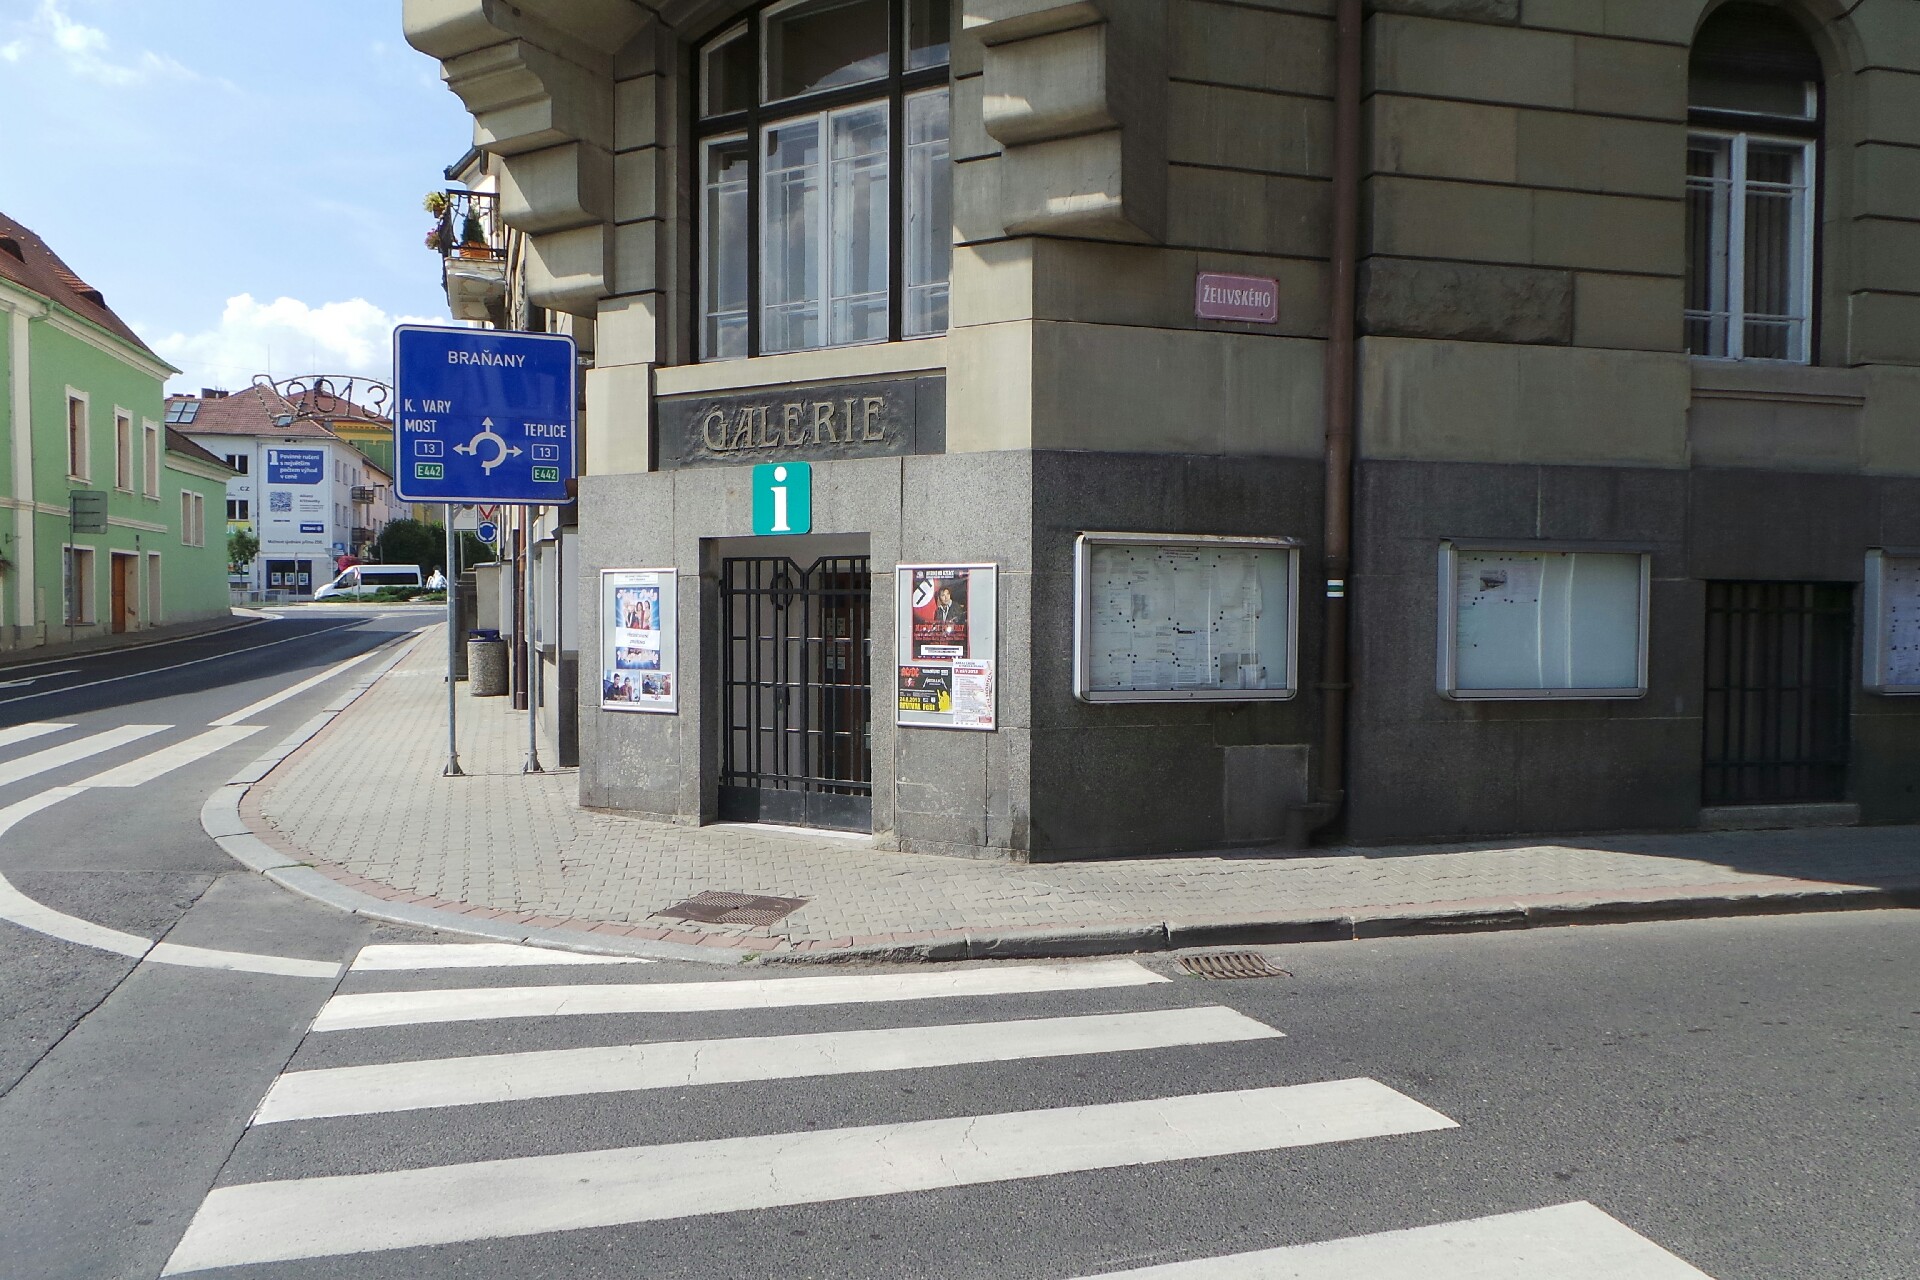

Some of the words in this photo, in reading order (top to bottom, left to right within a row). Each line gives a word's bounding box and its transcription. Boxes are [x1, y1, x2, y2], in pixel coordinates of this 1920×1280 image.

[1203, 284, 1271, 308] ŽELIVSKÉHO
[448, 349, 526, 368] BRAŇANY
[404, 398, 417, 413] K.
[422, 399, 452, 414] VARY
[404, 419, 437, 433] MOST
[523, 423, 567, 438] TEPLICE
[702, 396, 887, 452] GALERIE
[423, 443, 435, 454] 13
[539, 447, 551, 458] 13
[417, 465, 442, 477] E442
[534, 468, 557, 480] E442
